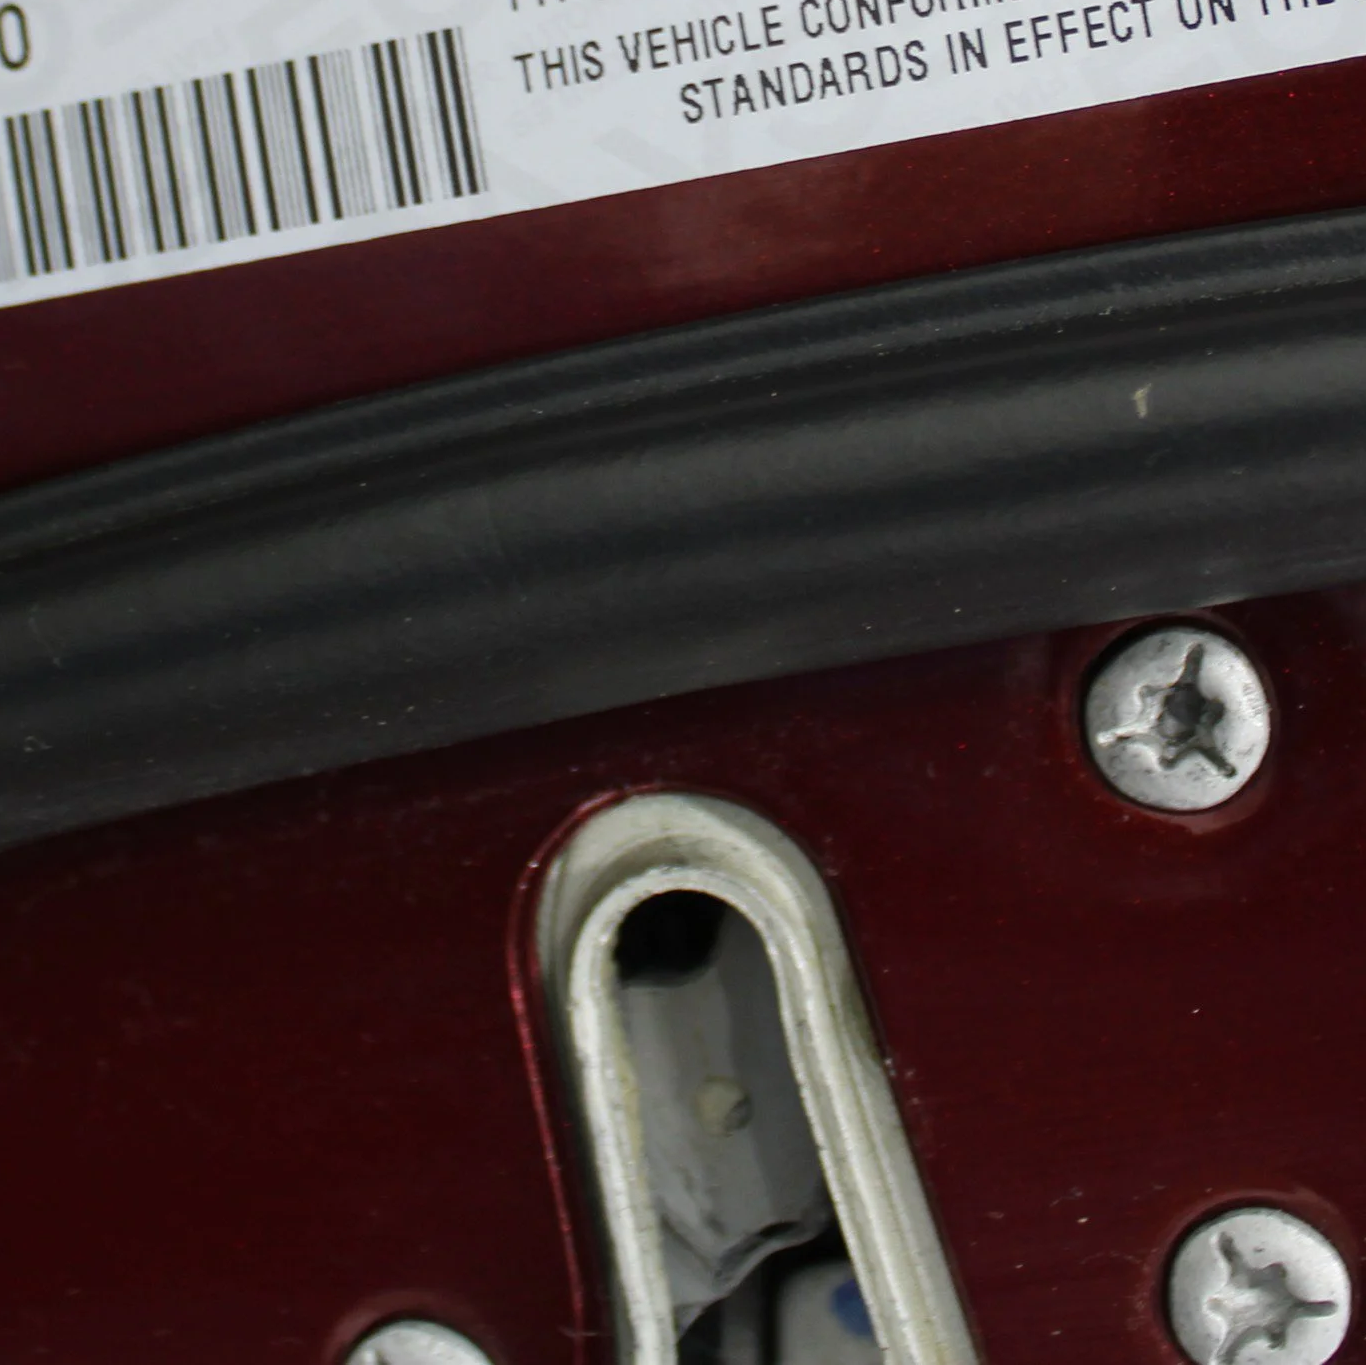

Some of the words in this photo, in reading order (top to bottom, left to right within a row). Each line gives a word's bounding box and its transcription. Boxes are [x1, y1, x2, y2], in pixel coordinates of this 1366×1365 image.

[513, 41, 604, 93] THIS
[617, 5, 785, 73] VEHICLE
[680, 40, 928, 124] STANDARDS
[946, 28, 988, 74] IN
